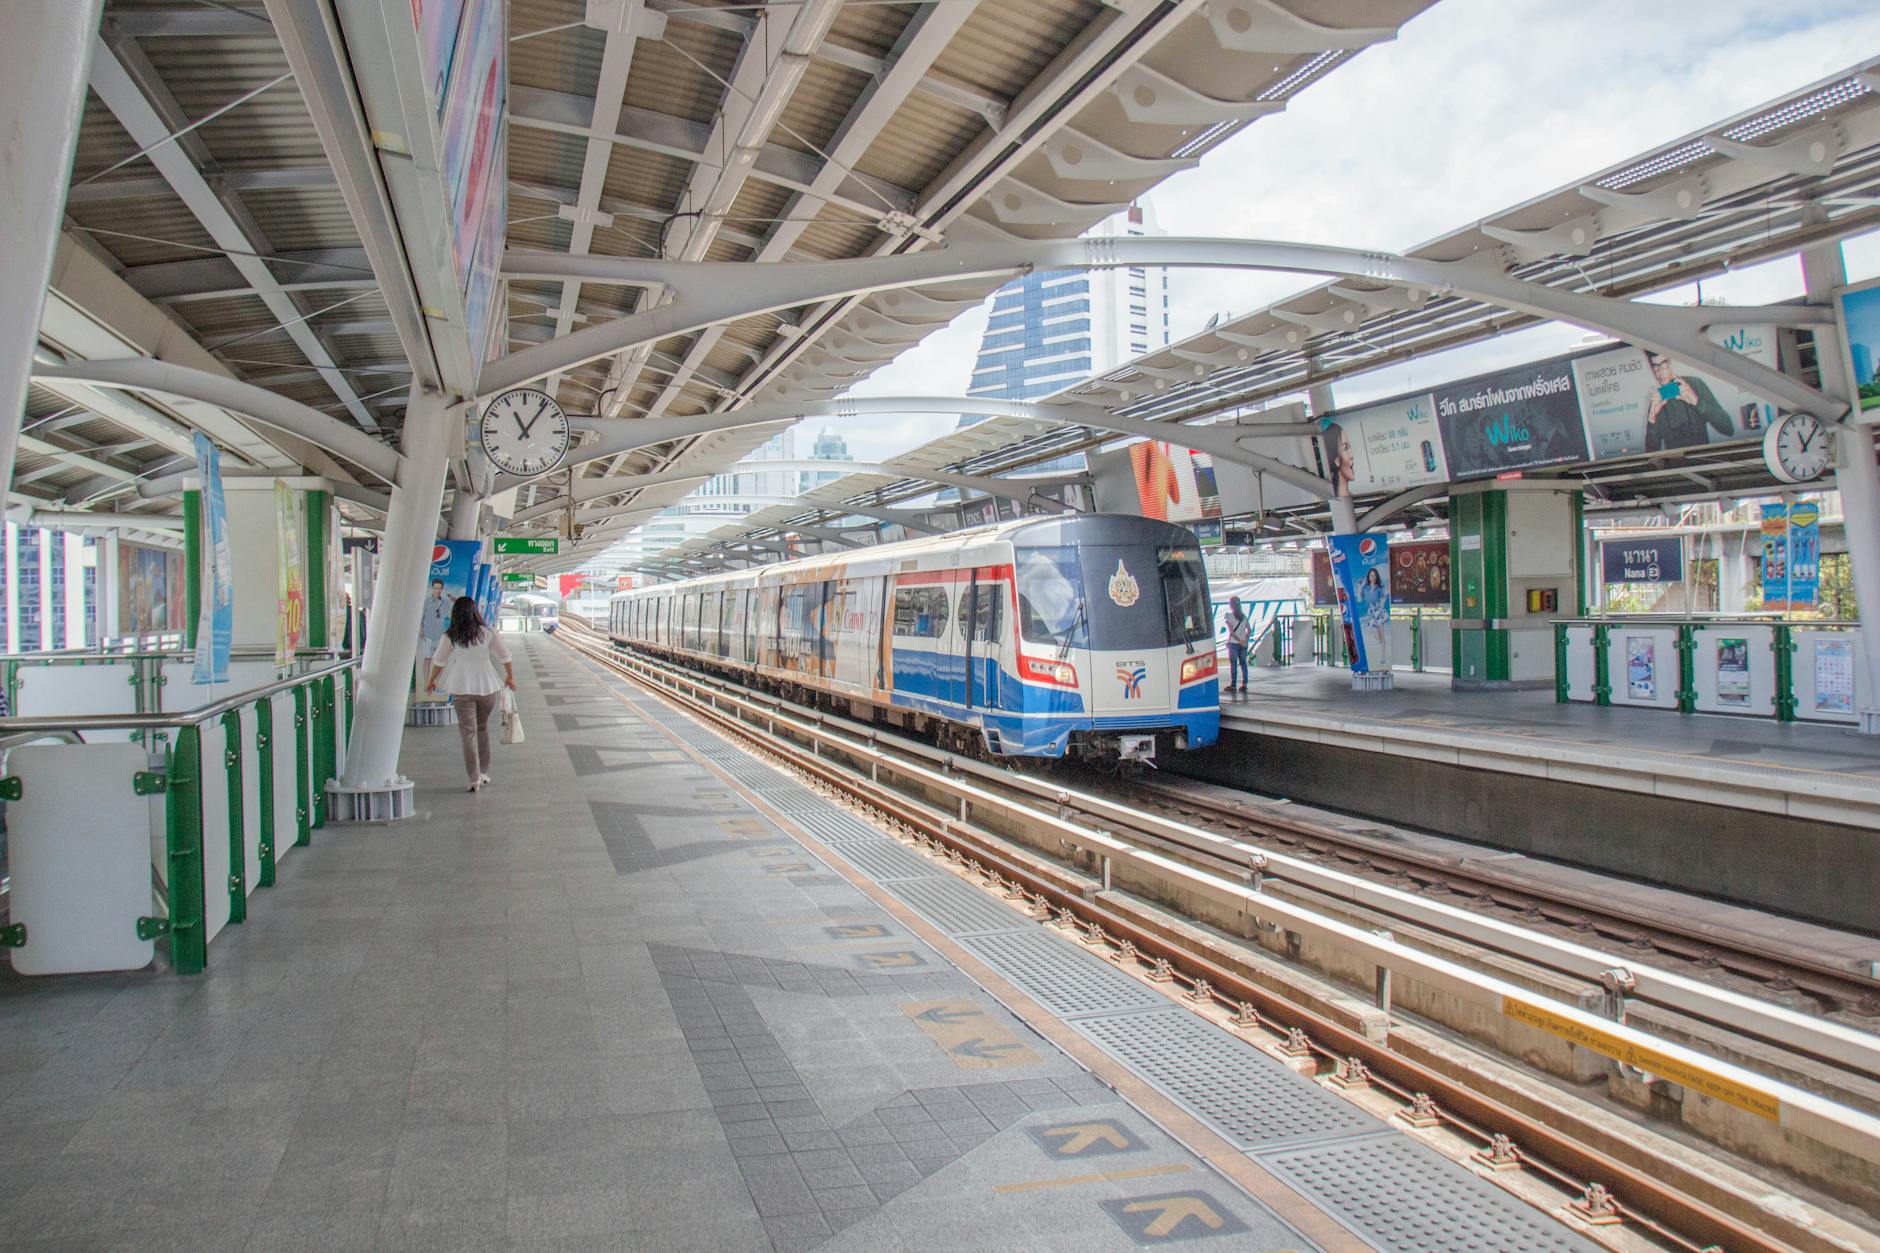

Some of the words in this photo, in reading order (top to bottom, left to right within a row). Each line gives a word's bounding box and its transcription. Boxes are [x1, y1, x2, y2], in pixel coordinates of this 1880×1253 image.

[1723, 329, 1763, 350] Wiko
[1485, 412, 1529, 446] Wiko
[528, 540, 554, 548] ทางออก
[1623, 549, 1658, 564] นานา
[1624, 568, 1646, 578] Nana
